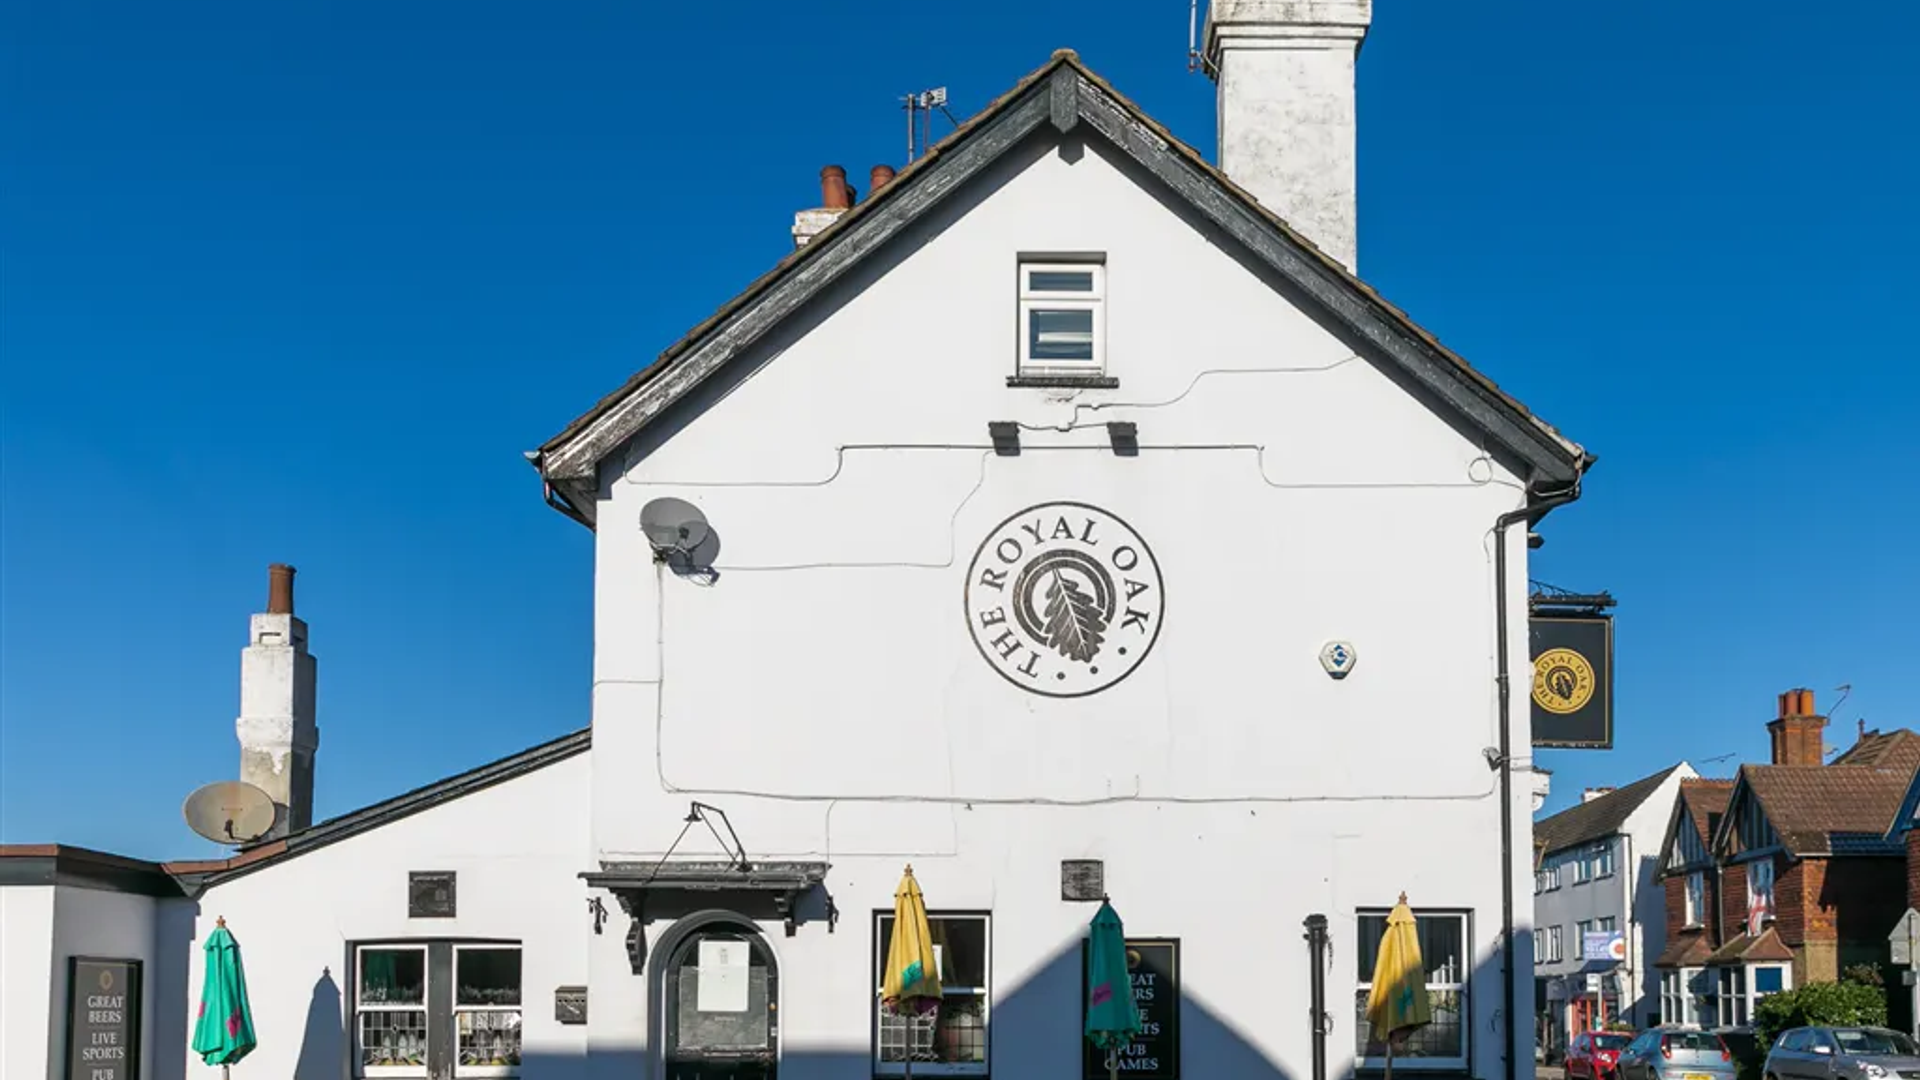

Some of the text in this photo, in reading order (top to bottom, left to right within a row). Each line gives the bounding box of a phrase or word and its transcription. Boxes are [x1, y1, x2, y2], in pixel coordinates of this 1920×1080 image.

[979, 515, 1151, 679] THE ROYAL OAK
[1536, 655, 1573, 678] ROYAL
[1129, 973, 1156, 986] EAT
[87, 995, 123, 1008] GREAT
[88, 1010, 122, 1023] BEERS
[91, 1032, 117, 1045] LIVE
[82, 1047, 125, 1060] SPORTS
[1117, 1044, 1147, 1056] PUB
[91, 1068, 114, 1080] PUB
